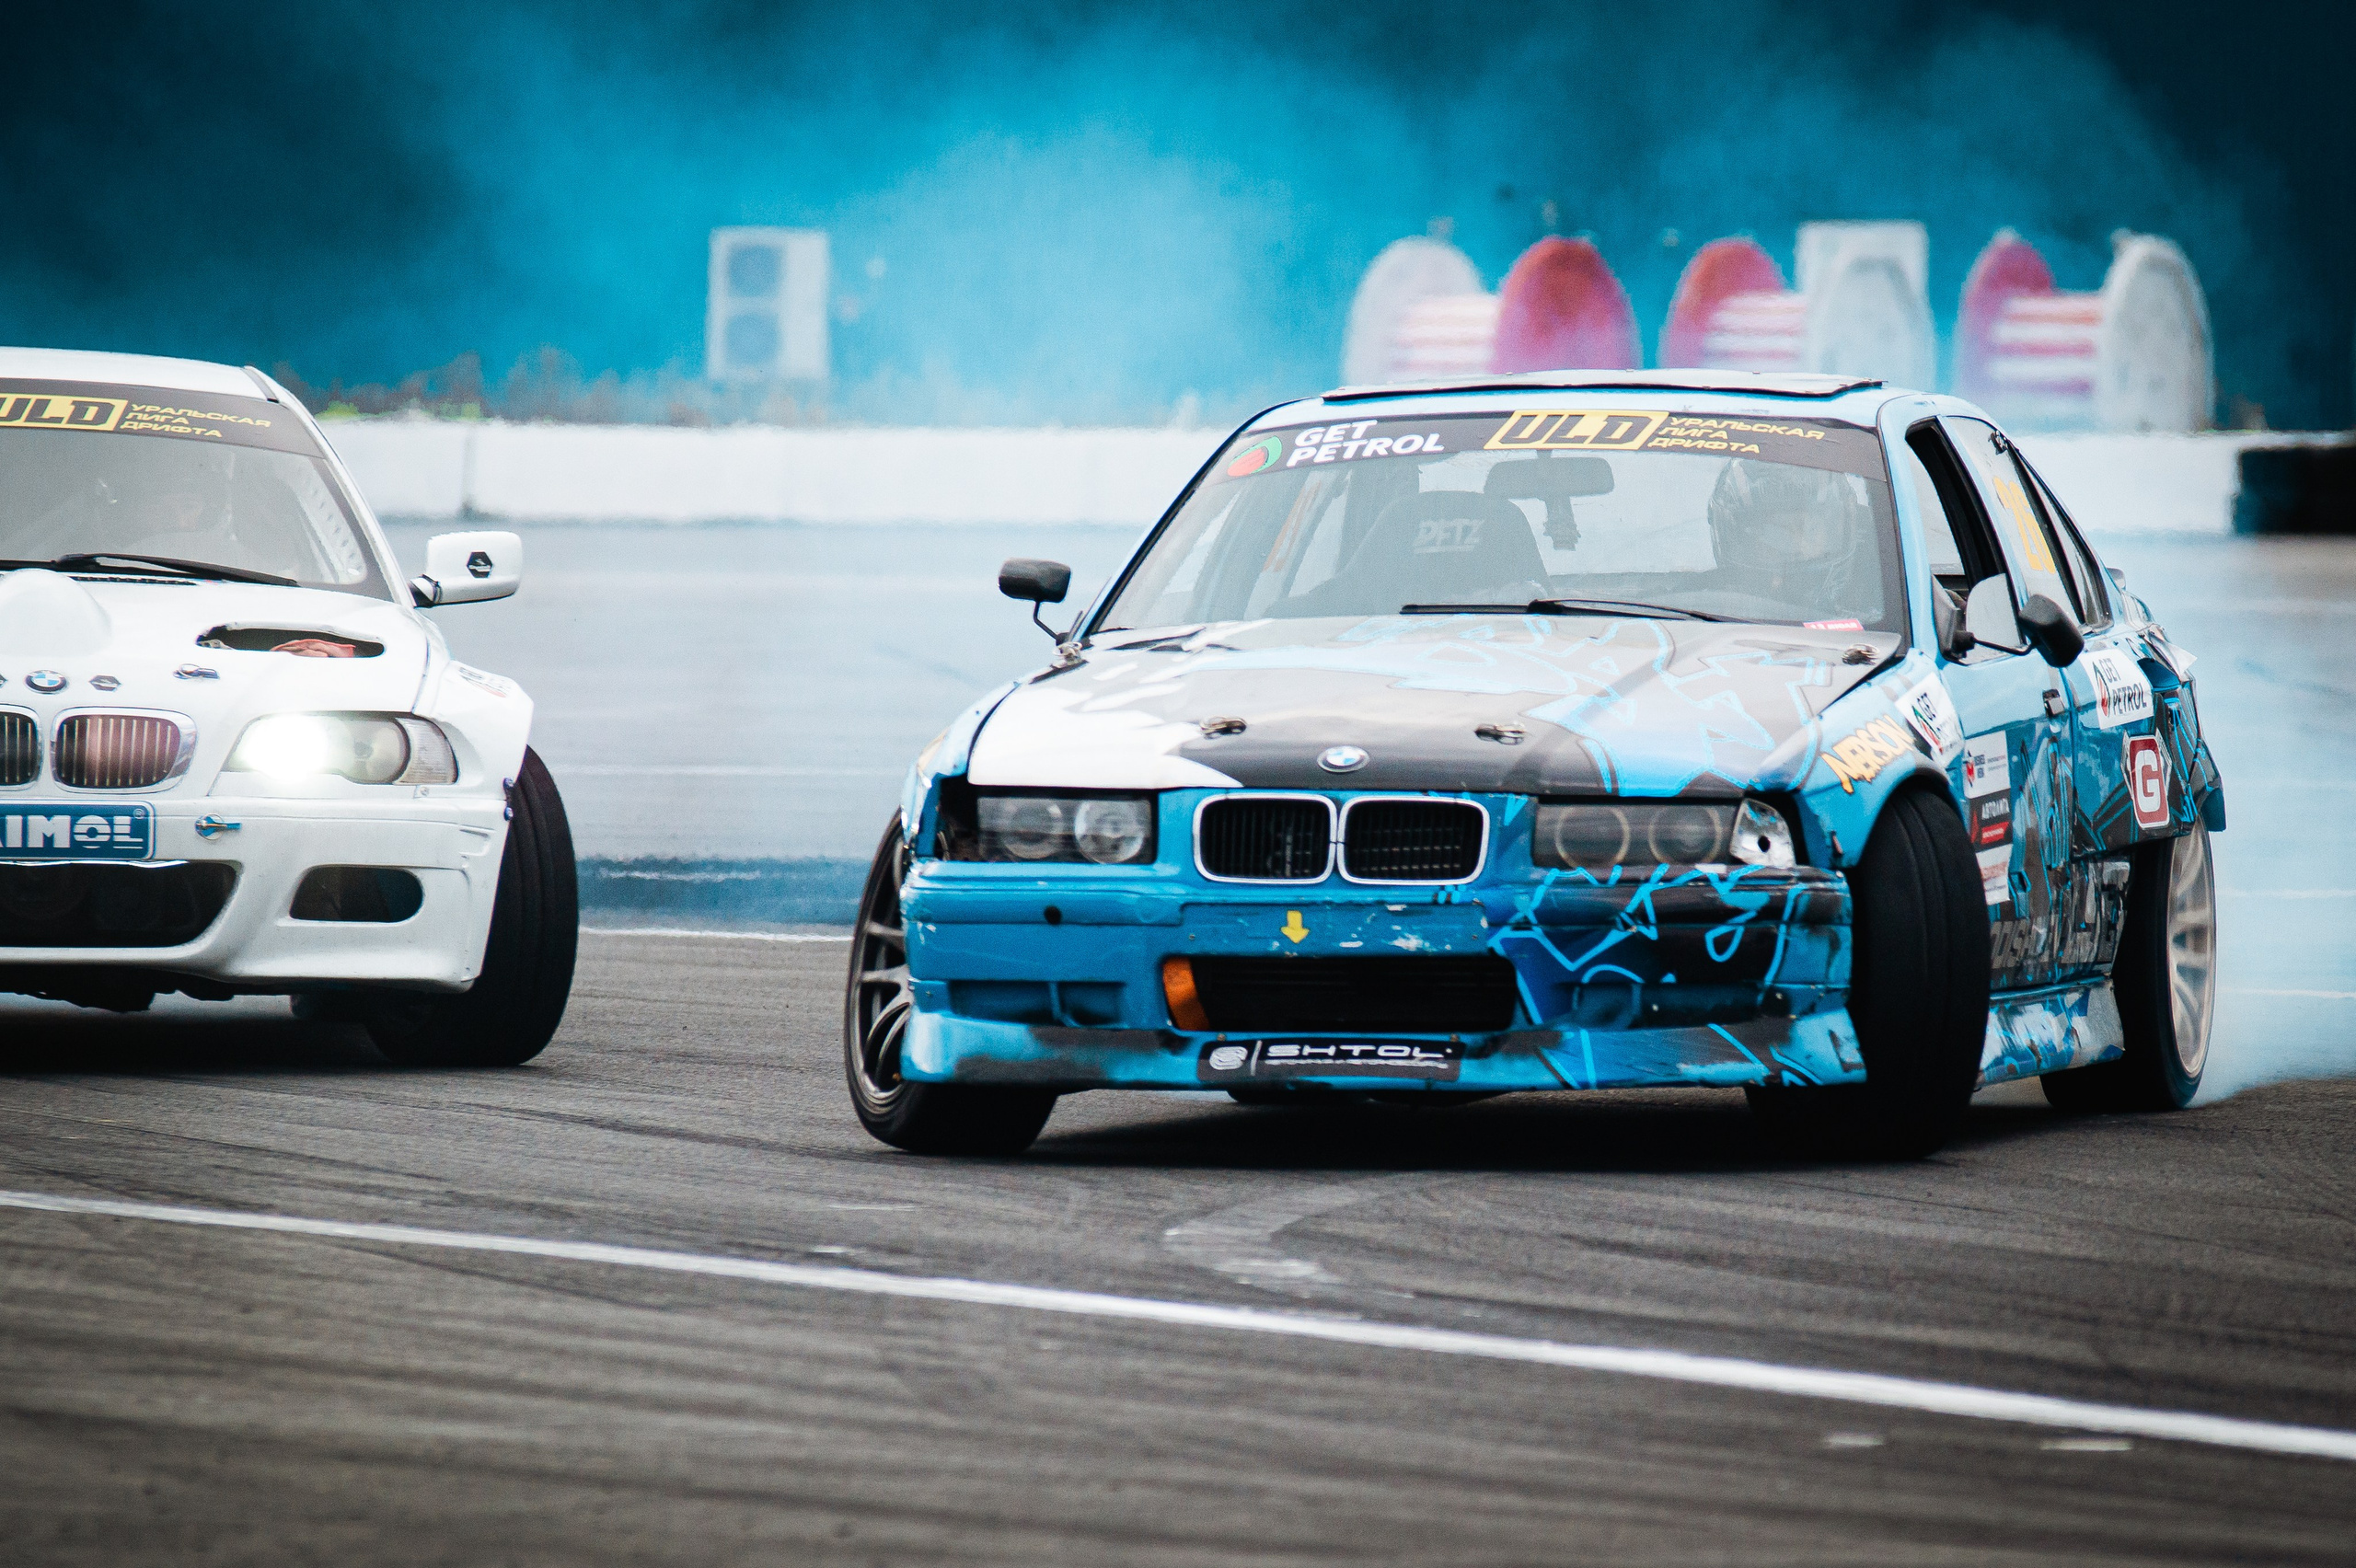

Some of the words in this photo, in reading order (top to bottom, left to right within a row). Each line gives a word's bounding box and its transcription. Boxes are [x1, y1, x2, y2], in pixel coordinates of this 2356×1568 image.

[126, 412, 190, 425] ЛИГА
[131, 403, 272, 428] УРАЛЬСКАЯ
[120, 421, 224, 438] ДРИФТА
[1294, 419, 1379, 447] GET
[1657, 426, 1729, 440] ЛИГА
[1669, 416, 1826, 441] УРАЛЬСКАЯ
[1286, 432, 1446, 467] PETROL
[1646, 436, 1761, 454] ДРИФТА
[2098, 656, 2122, 684] GET
[2111, 681, 2148, 716] PETROL
[2134, 748, 2161, 813] G
[0, 814, 144, 849] IMOL
[1265, 1043, 1445, 1058] SHTOL
